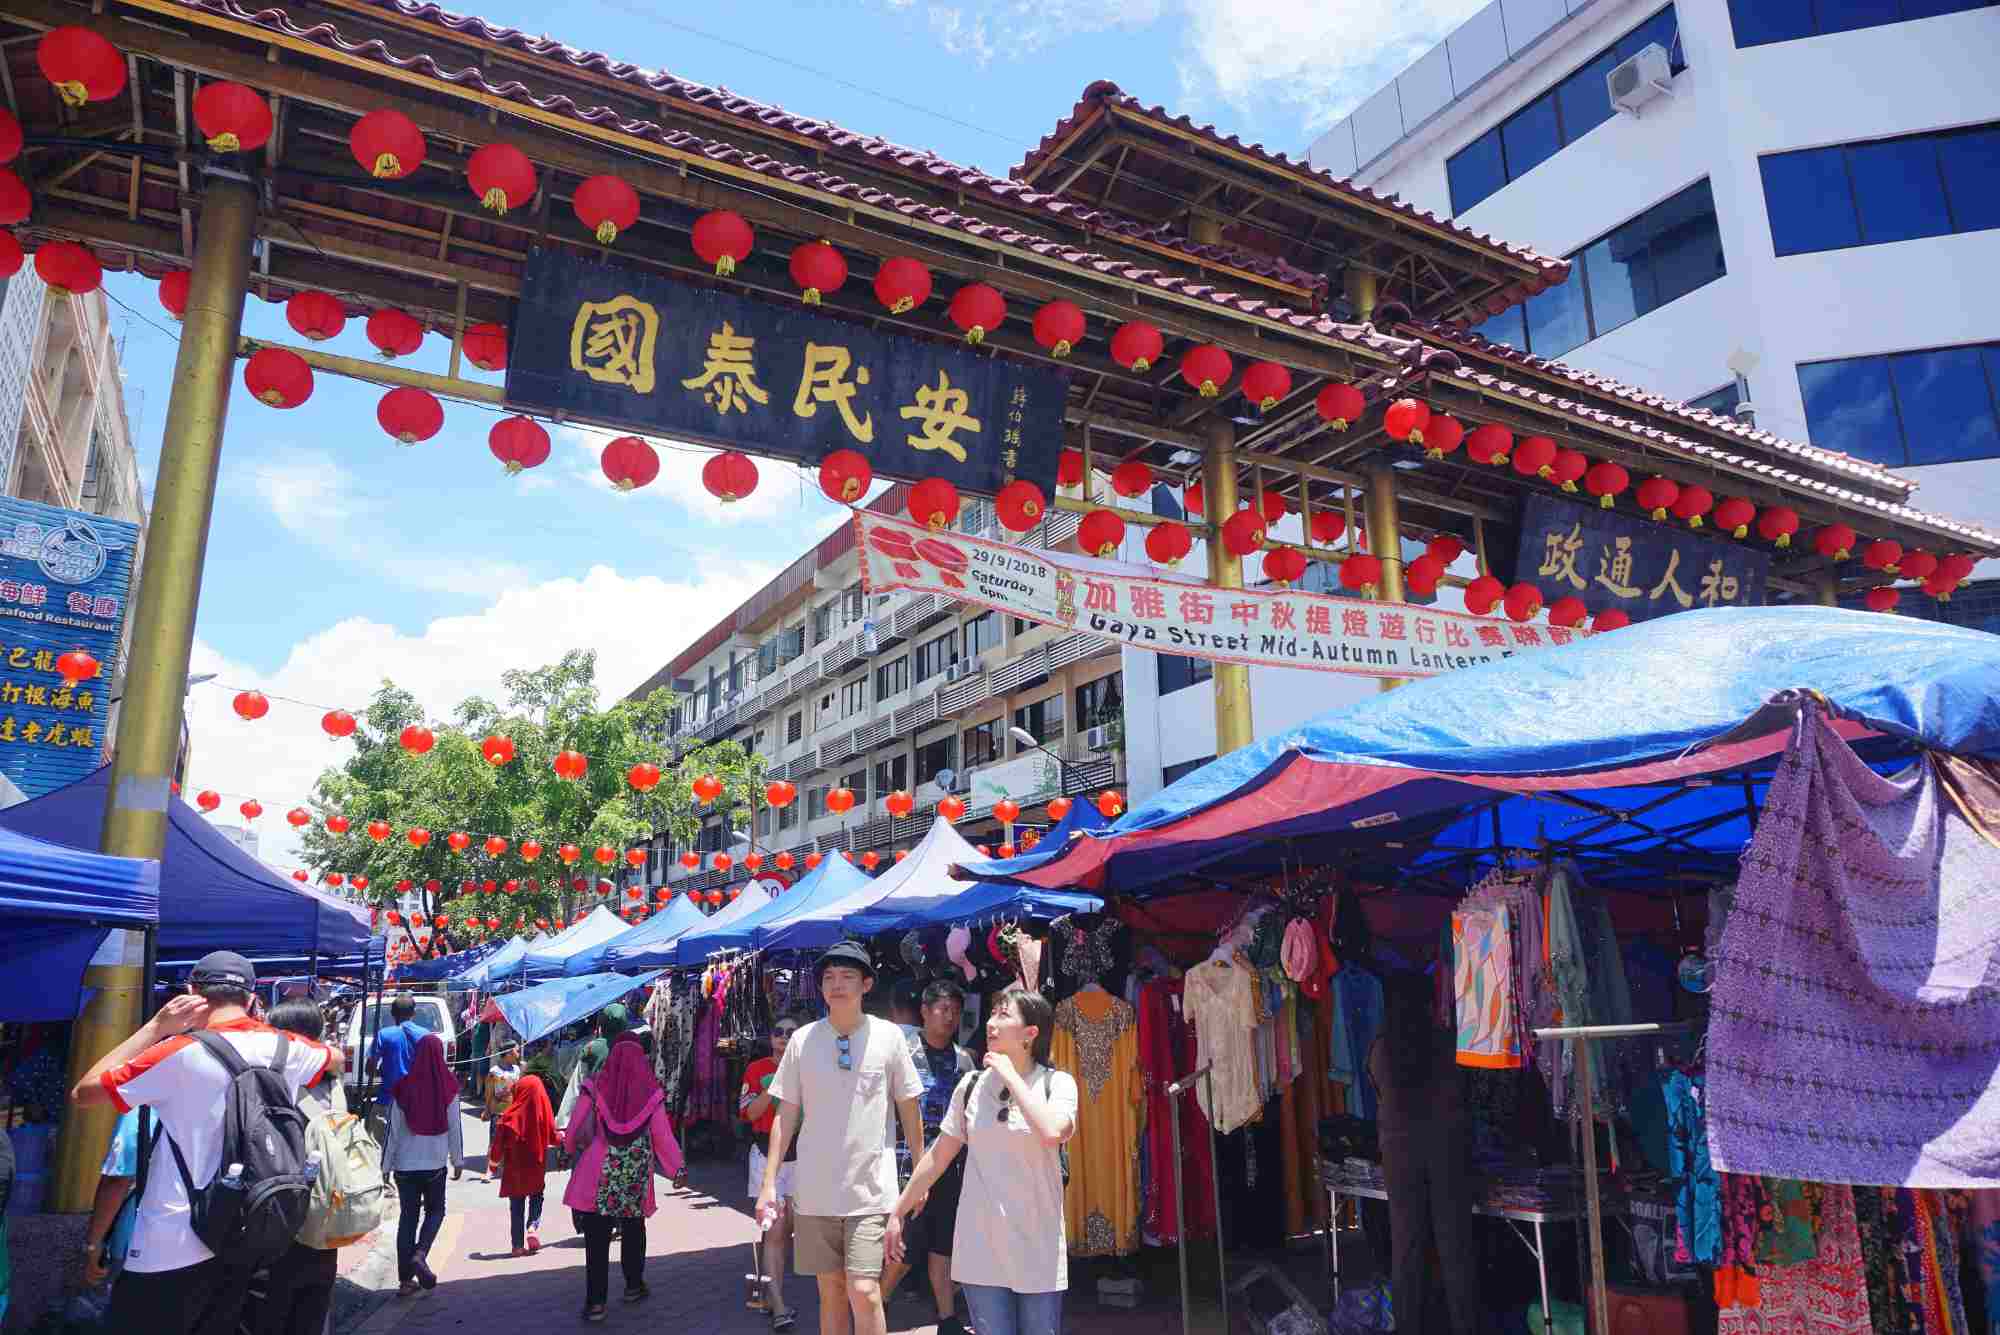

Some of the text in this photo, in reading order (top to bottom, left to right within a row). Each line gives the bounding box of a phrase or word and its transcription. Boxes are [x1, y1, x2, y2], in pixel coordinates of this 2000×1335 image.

[570, 294, 982, 463] 國泰民安
[972, 549, 1047, 578] 29/9/2018
[1538, 522, 1739, 608] 政通人和
[971, 569, 1034, 596] Saturday
[980, 585, 1009, 601] 6pm
[45, 613, 114, 632] Restaurant
[1090, 613, 1491, 670] Gaya Street Mid-Autumn Lantern
